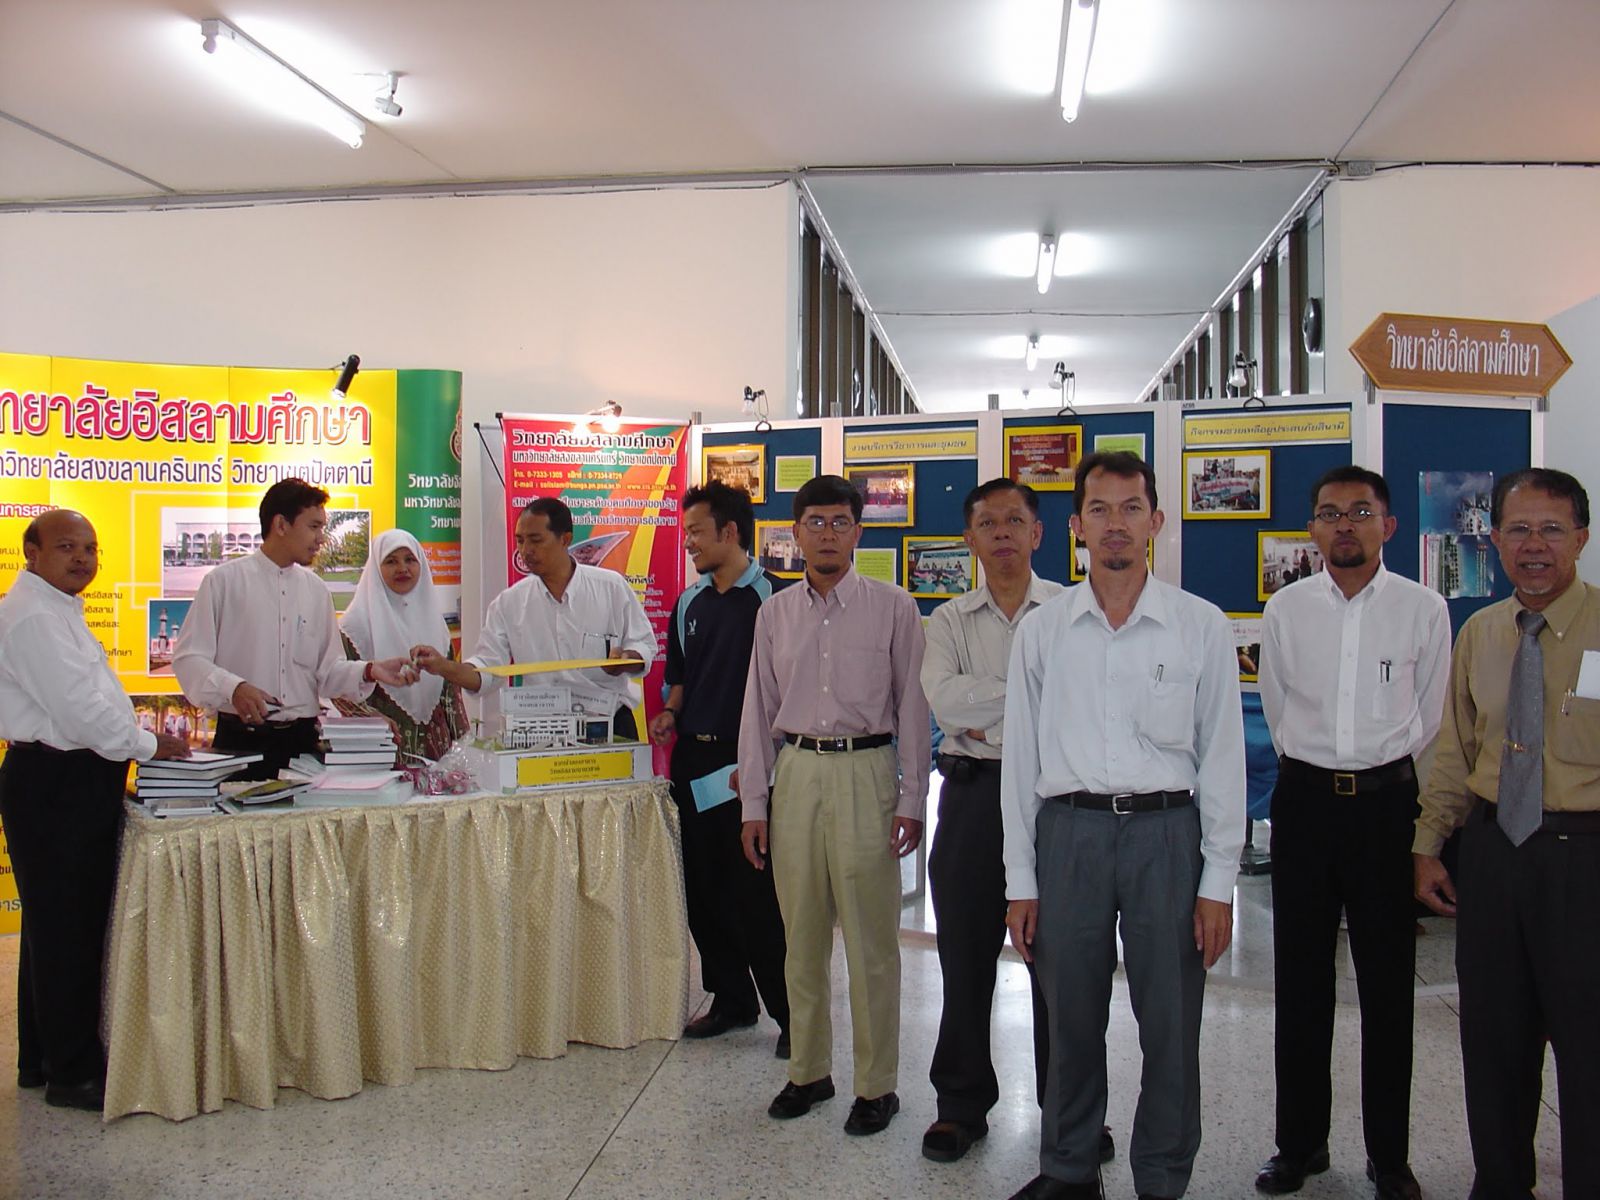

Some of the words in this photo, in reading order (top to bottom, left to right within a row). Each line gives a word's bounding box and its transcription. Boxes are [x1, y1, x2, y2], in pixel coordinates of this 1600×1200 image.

[1386, 323, 1540, 377] วิทยาลัยอิสลามศึกษา
[513, 429, 675, 449] วิทยาลัยอสลามศึกษา
